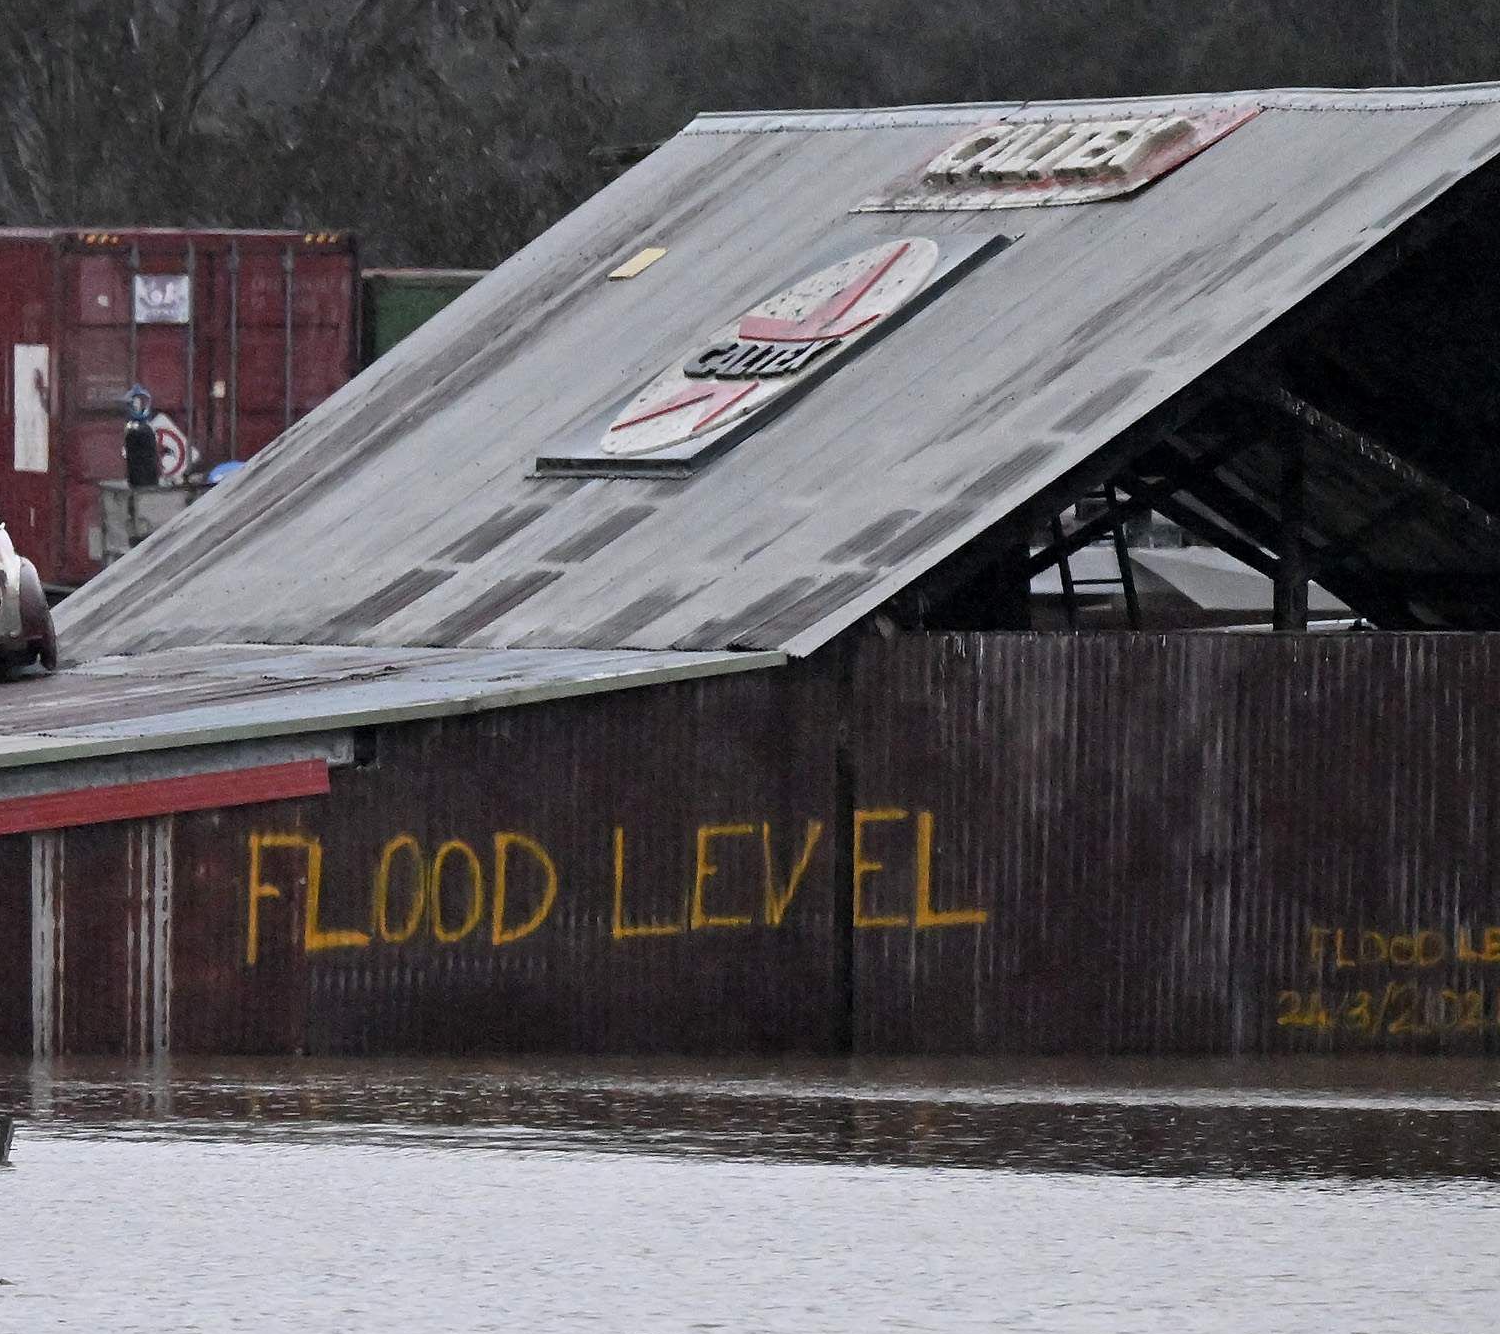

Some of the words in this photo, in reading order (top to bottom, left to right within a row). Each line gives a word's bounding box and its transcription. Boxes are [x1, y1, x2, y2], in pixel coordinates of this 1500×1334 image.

[921, 116, 1195, 185] CALTEX
[683, 339, 842, 381] CALTEX
[247, 830, 557, 965] FLOOD
[612, 810, 988, 939] LEVEL
[1309, 926, 1445, 968] FLOOD
